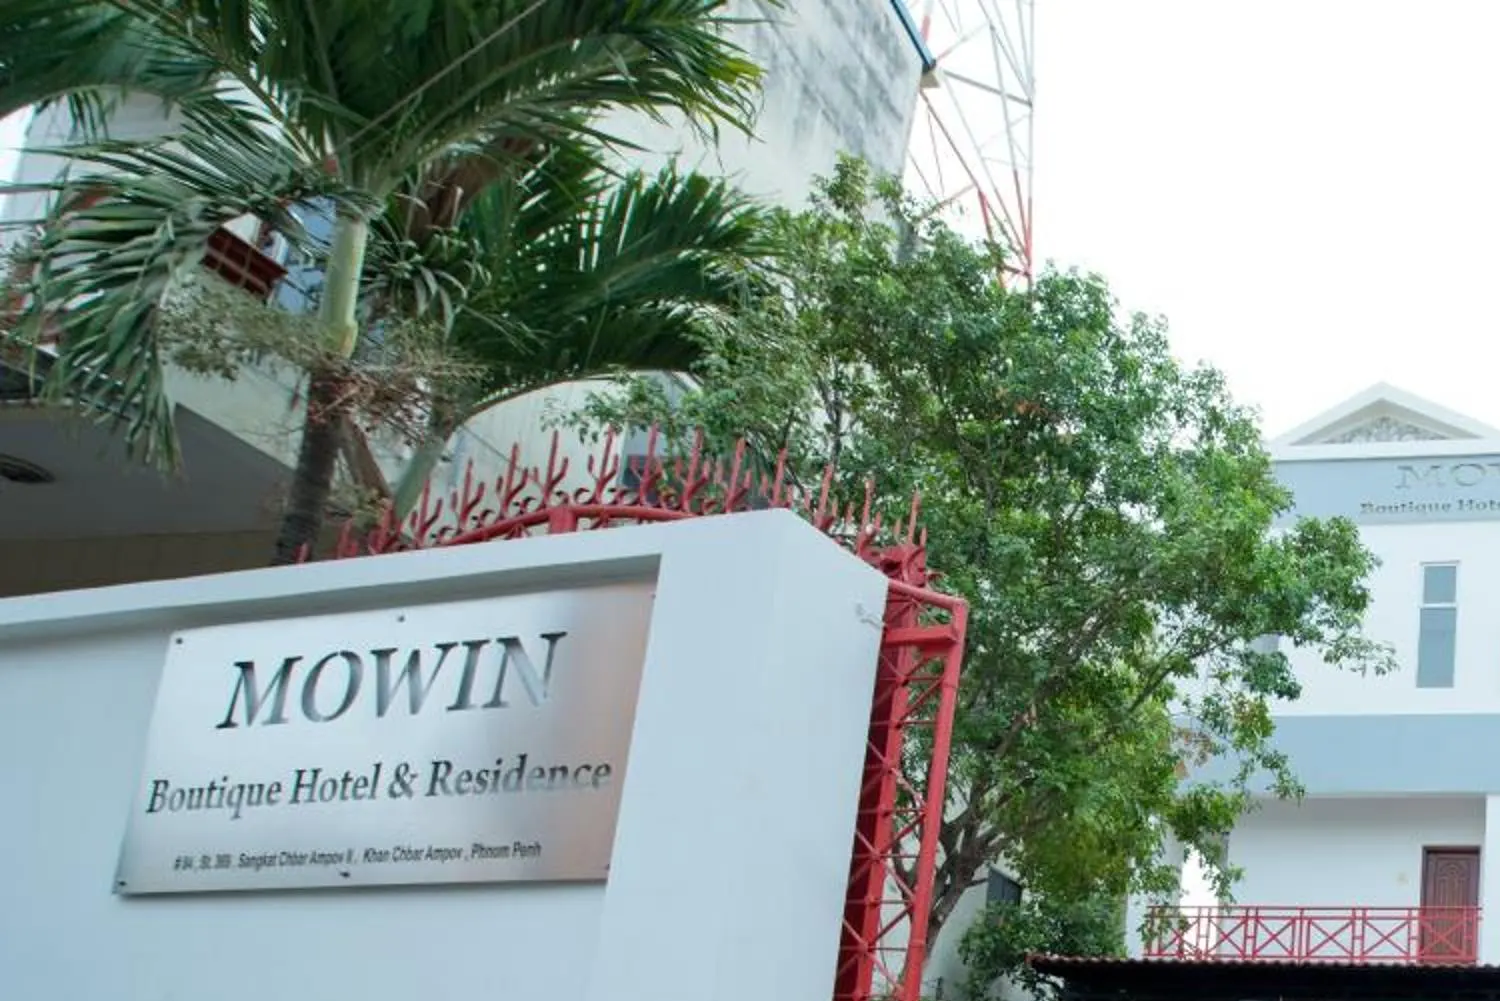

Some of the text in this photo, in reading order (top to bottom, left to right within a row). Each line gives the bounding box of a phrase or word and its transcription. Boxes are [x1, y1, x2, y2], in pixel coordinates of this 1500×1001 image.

[1359, 500, 1452, 516] Boutique
[216, 631, 567, 729] MOWIN
[146, 754, 612, 819] Boutique Hotel & Residence
